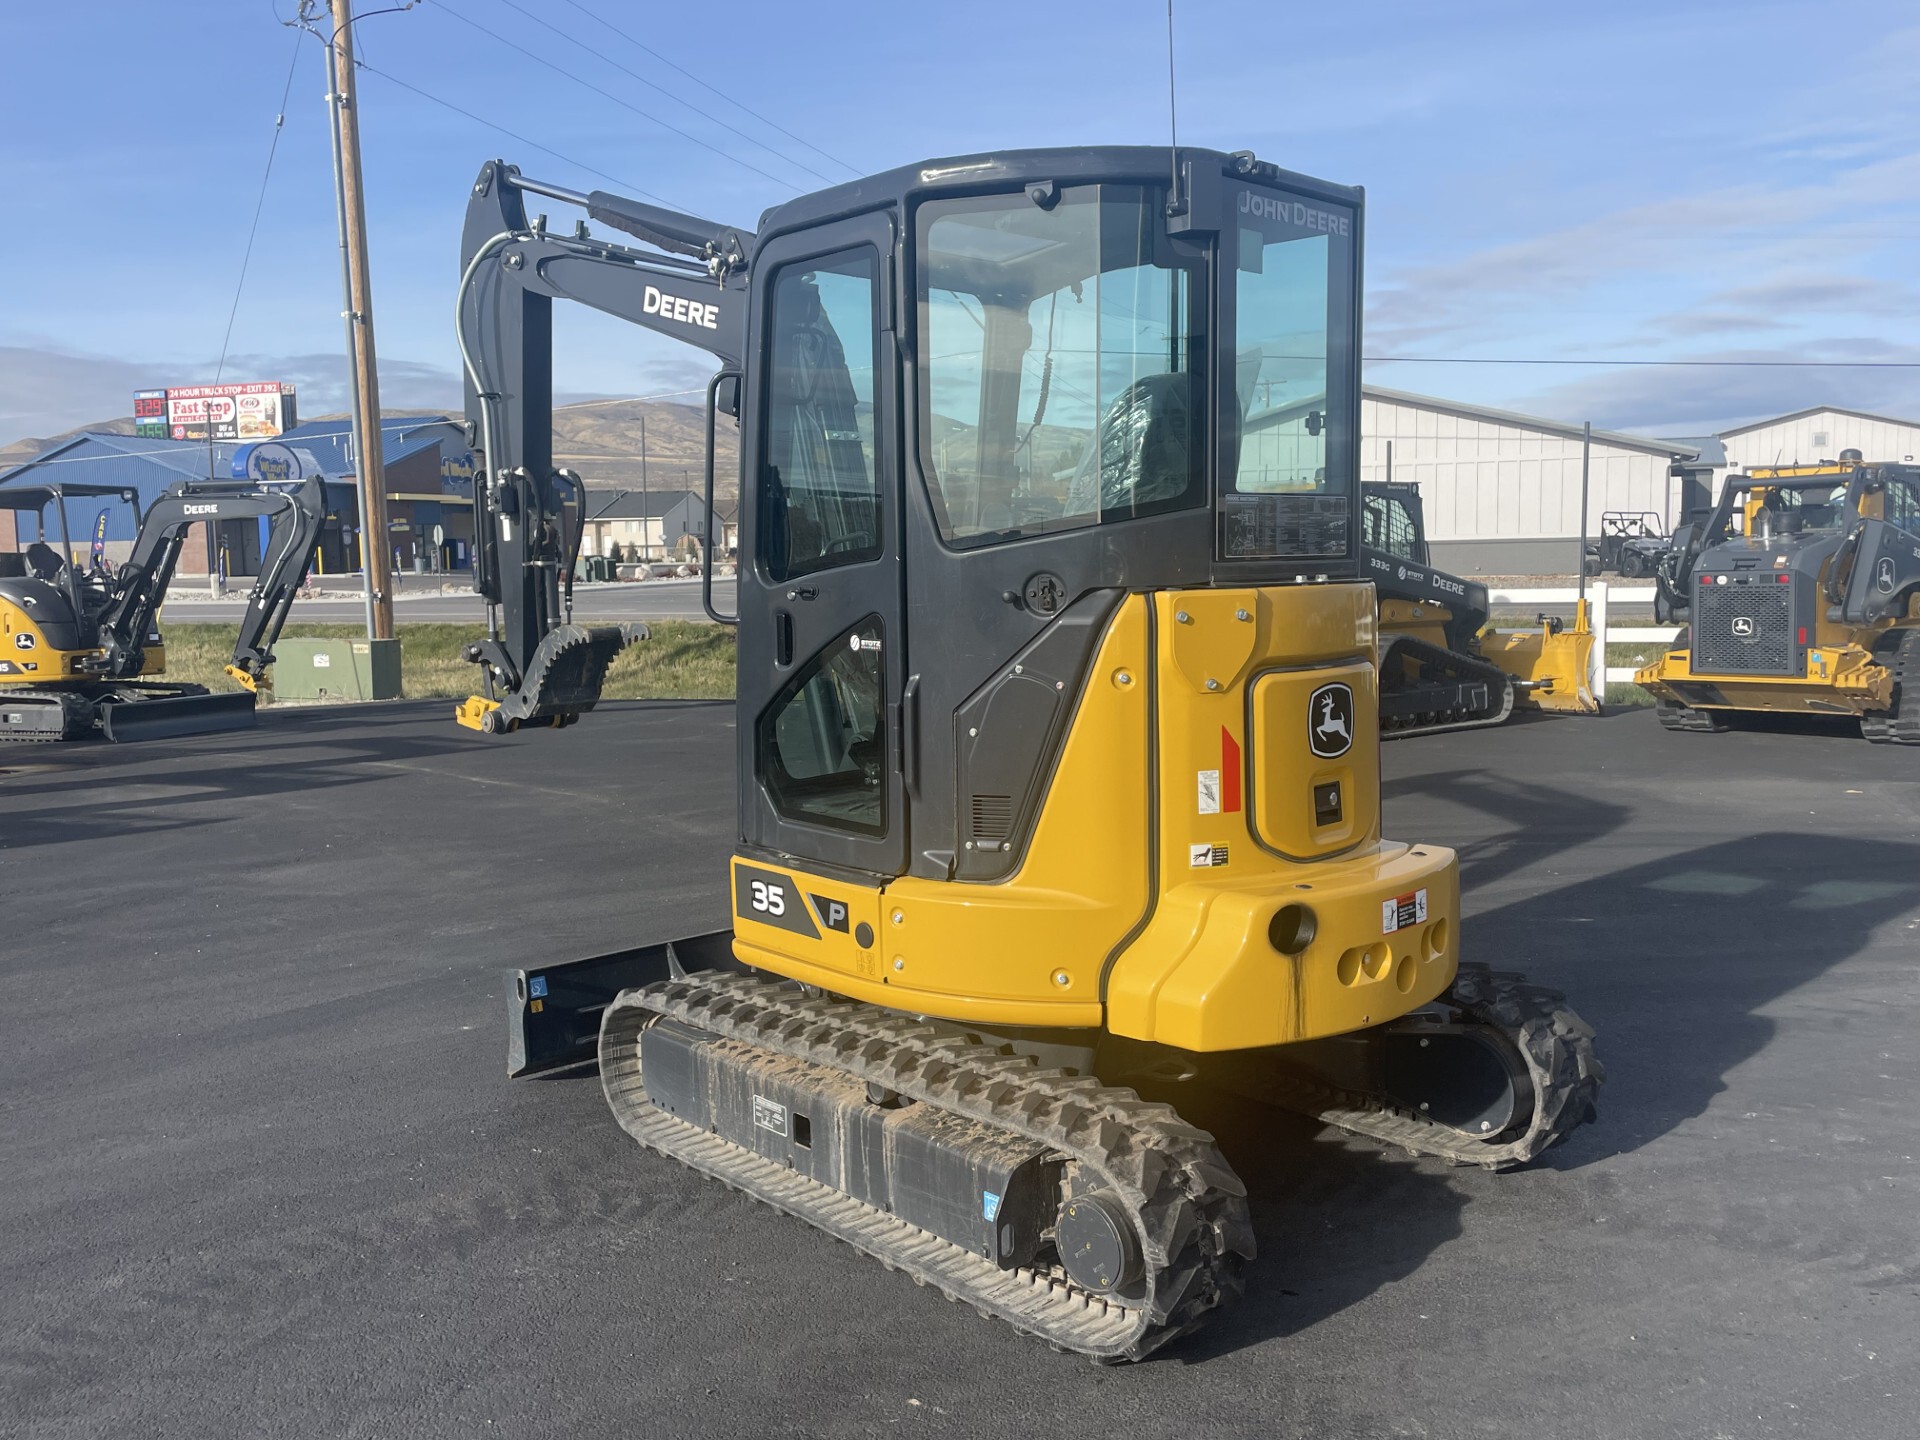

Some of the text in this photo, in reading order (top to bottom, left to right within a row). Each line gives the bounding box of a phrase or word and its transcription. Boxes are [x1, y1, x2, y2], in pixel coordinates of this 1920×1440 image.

[1240, 190, 1349, 237] JOHN DEERE
[643, 285, 719, 329] DEERE
[169, 390, 179, 398] 24
[179, 388, 200, 397] HOUR
[200, 386, 224, 396] TRUCK
[224, 385, 243, 395] STOP
[246, 383, 263, 394] EXIT
[263, 383, 277, 393] 392
[172, 401, 200, 415] Fast
[201, 400, 231, 415] Stop
[183, 504, 218, 515] DEERE
[97, 515, 106, 539] CAR
[1370, 558, 1391, 572] 333G
[1432, 574, 1465, 596] DEERE
[751, 880, 786, 916] 35
[828, 902, 846, 927] P
